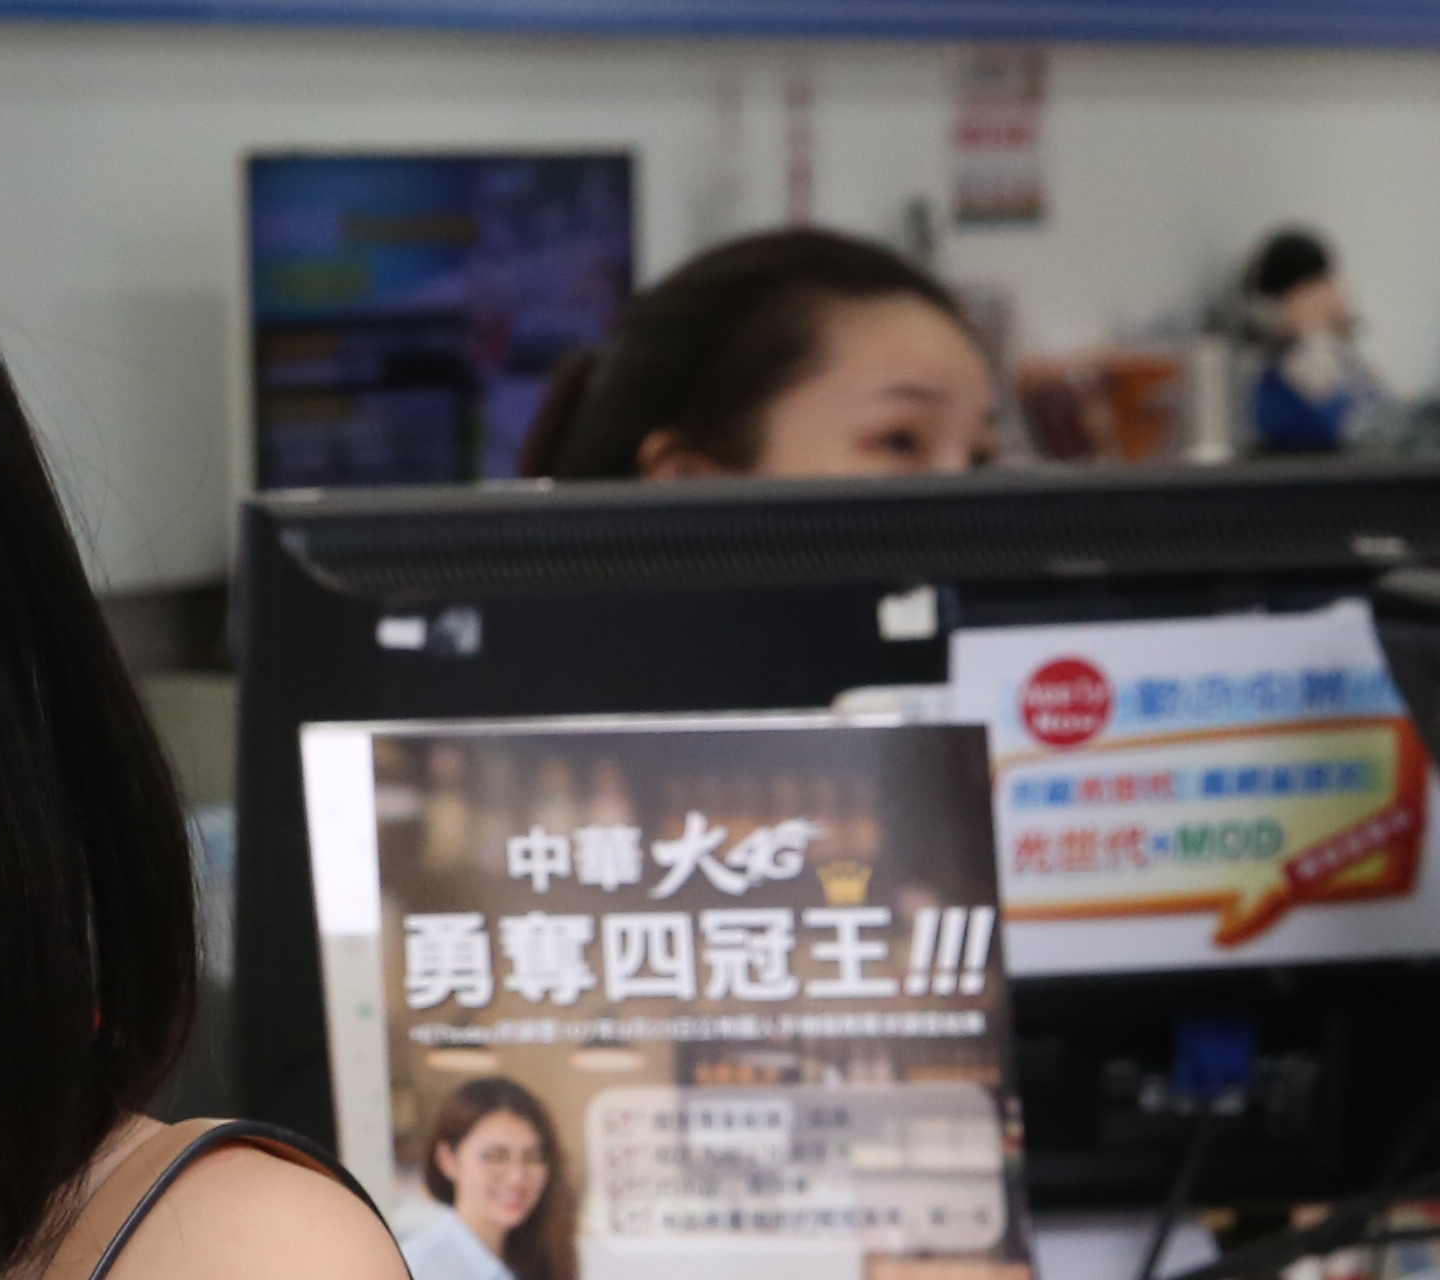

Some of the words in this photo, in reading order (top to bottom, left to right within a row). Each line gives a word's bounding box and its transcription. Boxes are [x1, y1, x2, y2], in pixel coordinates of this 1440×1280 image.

[403, 904, 996, 1011] 勇奪四冠王!!!
